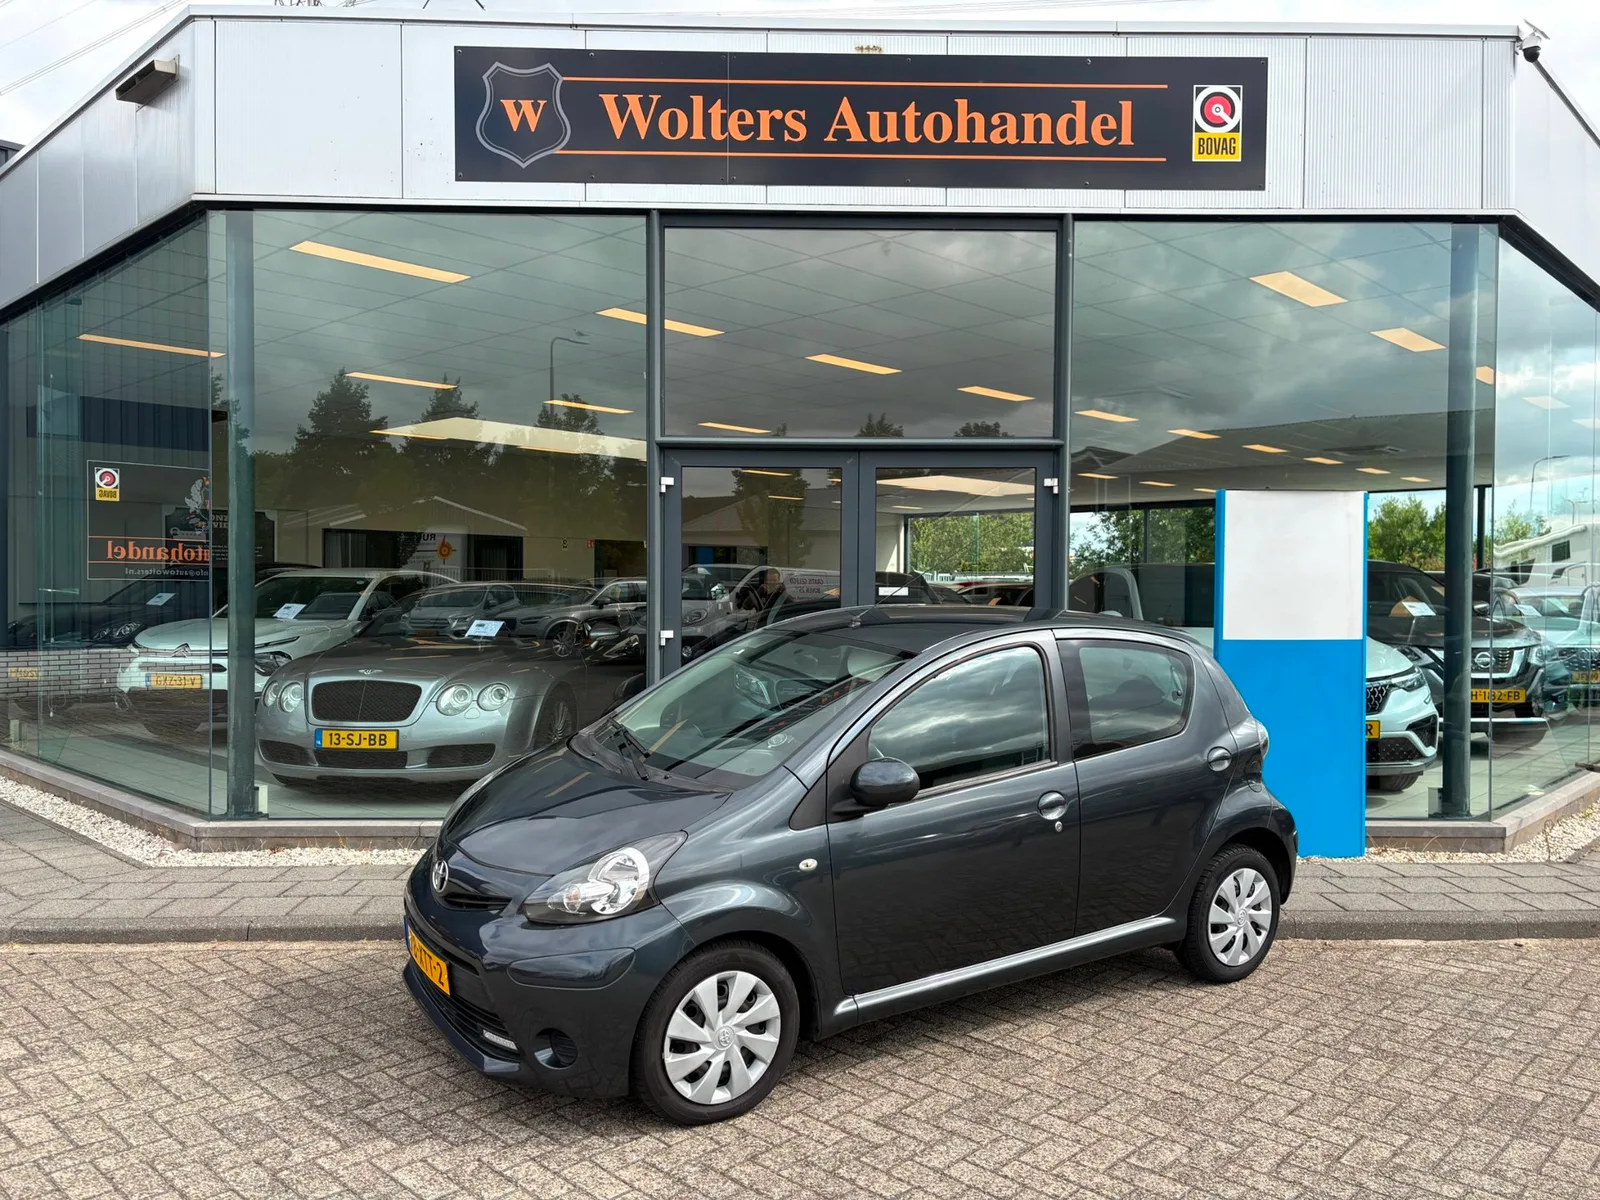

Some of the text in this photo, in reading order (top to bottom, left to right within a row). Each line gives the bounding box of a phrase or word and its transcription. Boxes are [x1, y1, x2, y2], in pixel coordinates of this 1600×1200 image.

[500, 99, 547, 132] W
[600, 93, 1135, 147] Wolters Autohandel
[1198, 137, 1236, 155] BOVAG
[329, 732, 387, 746] 13-SJ-BB
